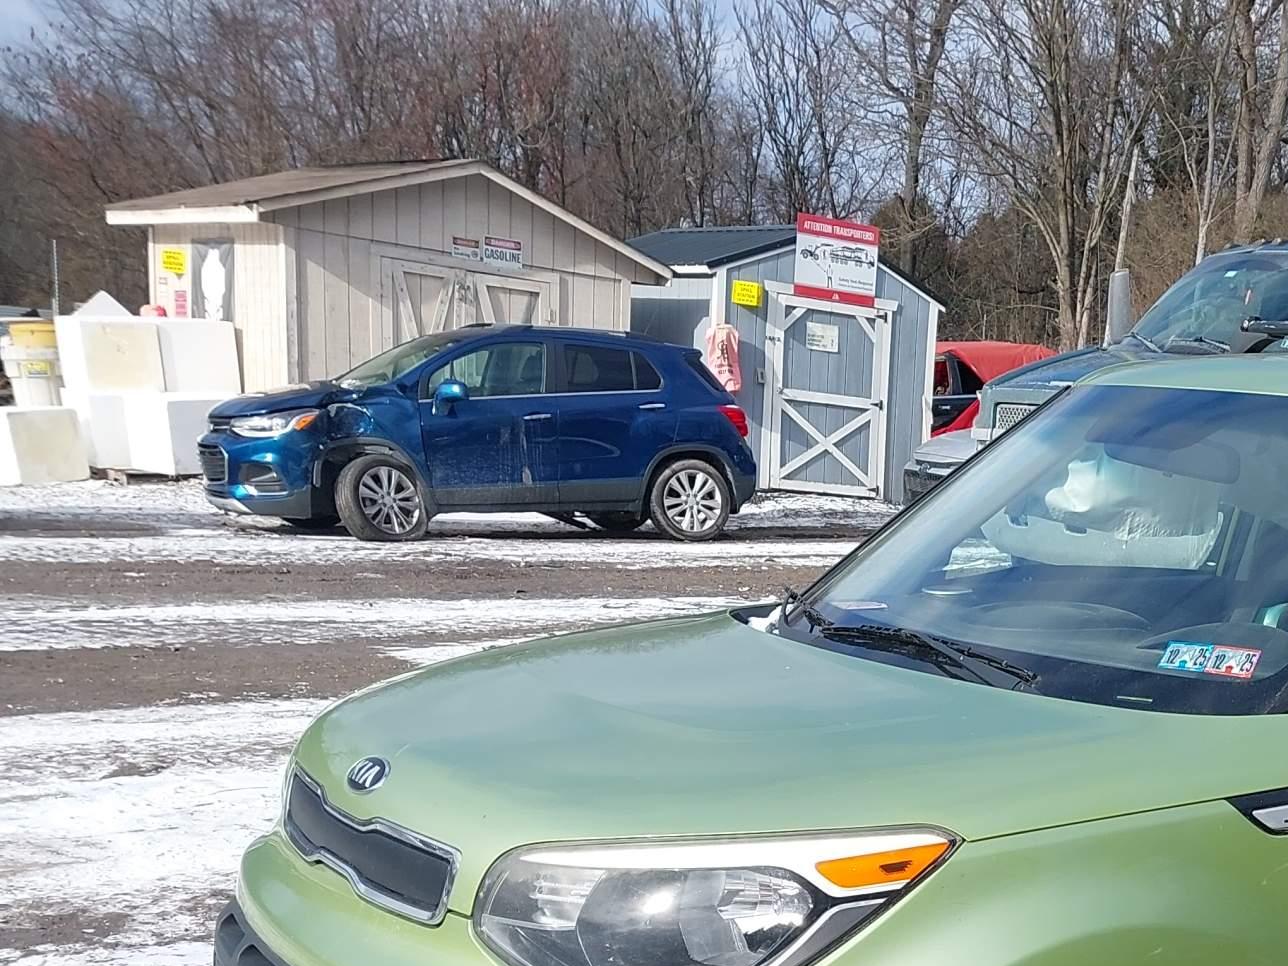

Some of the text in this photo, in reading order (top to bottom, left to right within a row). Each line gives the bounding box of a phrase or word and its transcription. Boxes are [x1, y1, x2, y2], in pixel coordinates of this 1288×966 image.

[803, 220, 875, 241] ATTENTION TRANSPORTERS!
[484, 248, 521, 264] GASOLINE
[1166, 648, 1208, 667] 12 25
[1212, 653, 1257, 673] 12 25
